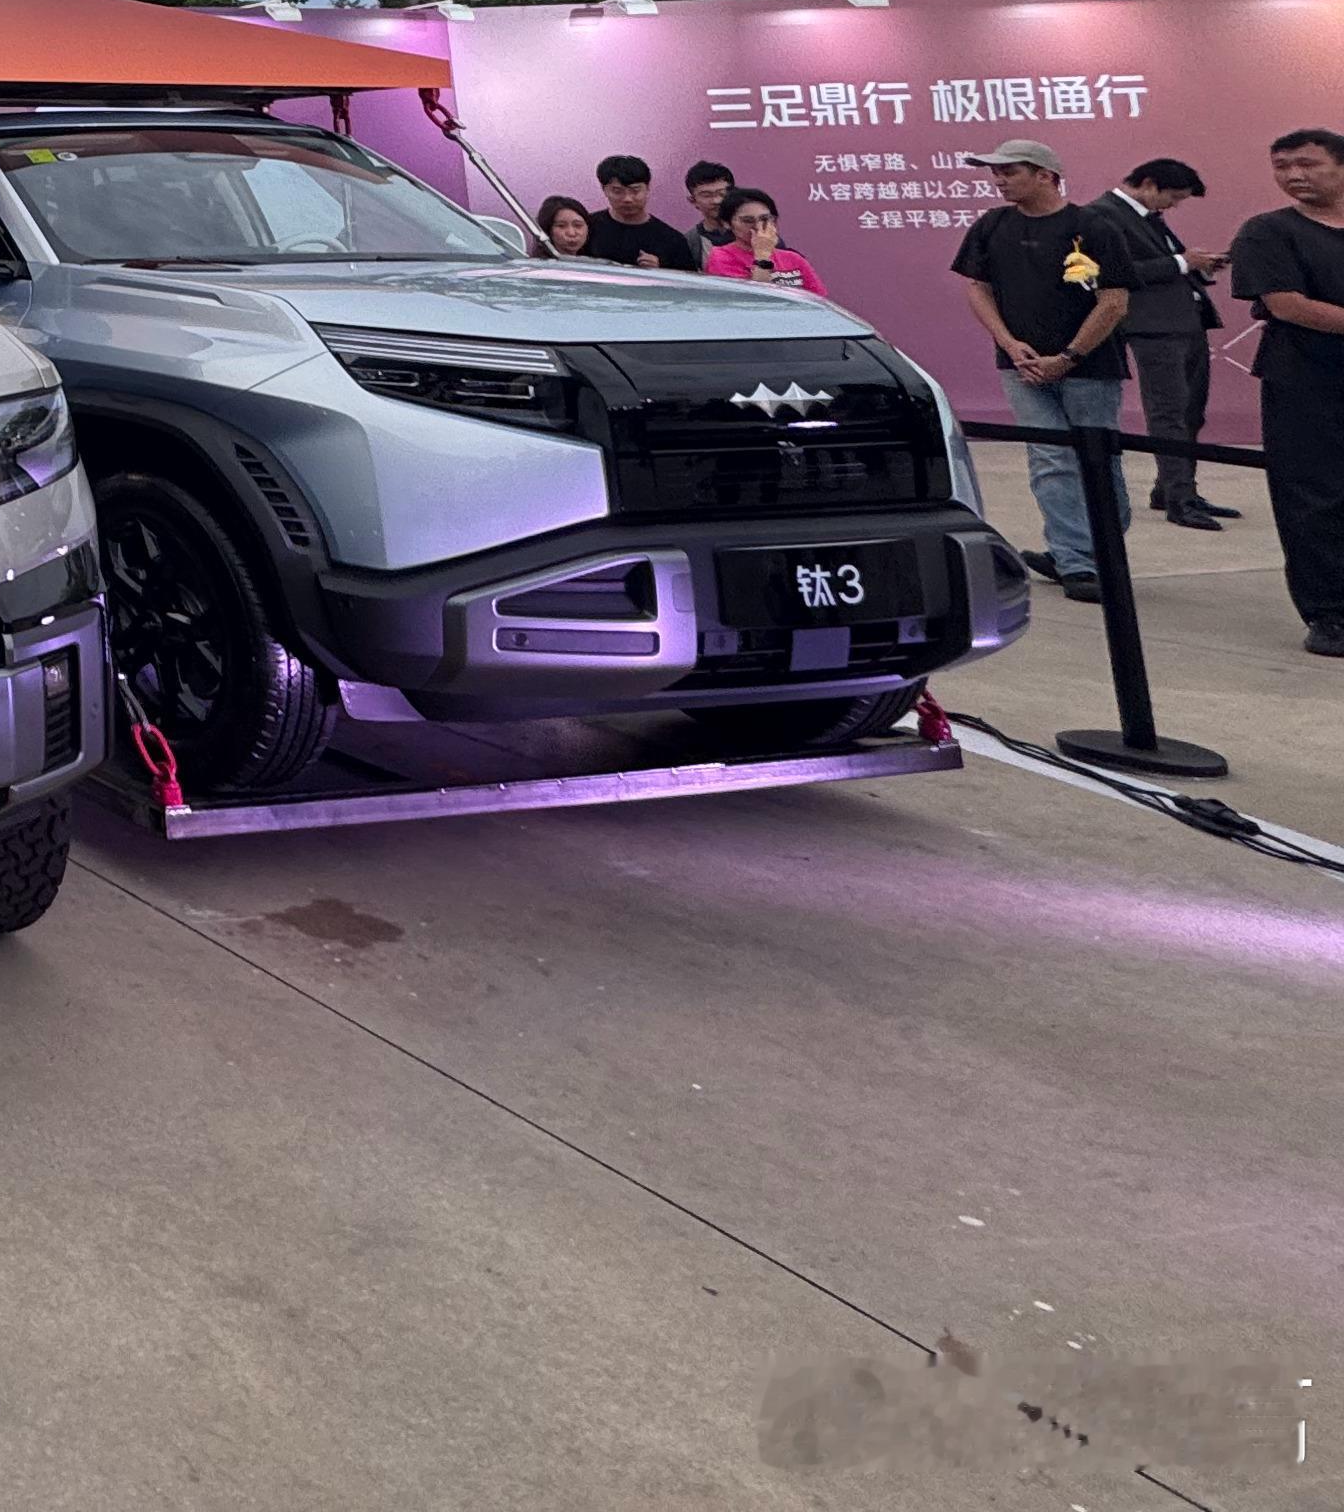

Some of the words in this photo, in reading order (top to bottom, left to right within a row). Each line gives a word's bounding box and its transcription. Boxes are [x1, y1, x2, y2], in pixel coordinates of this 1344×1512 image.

[706, 81, 912, 129] 三足鼎行
[929, 74, 1148, 123] 极限通行
[858, 208, 988, 229] 全程平稳无
[796, 564, 864, 607] 钛3
